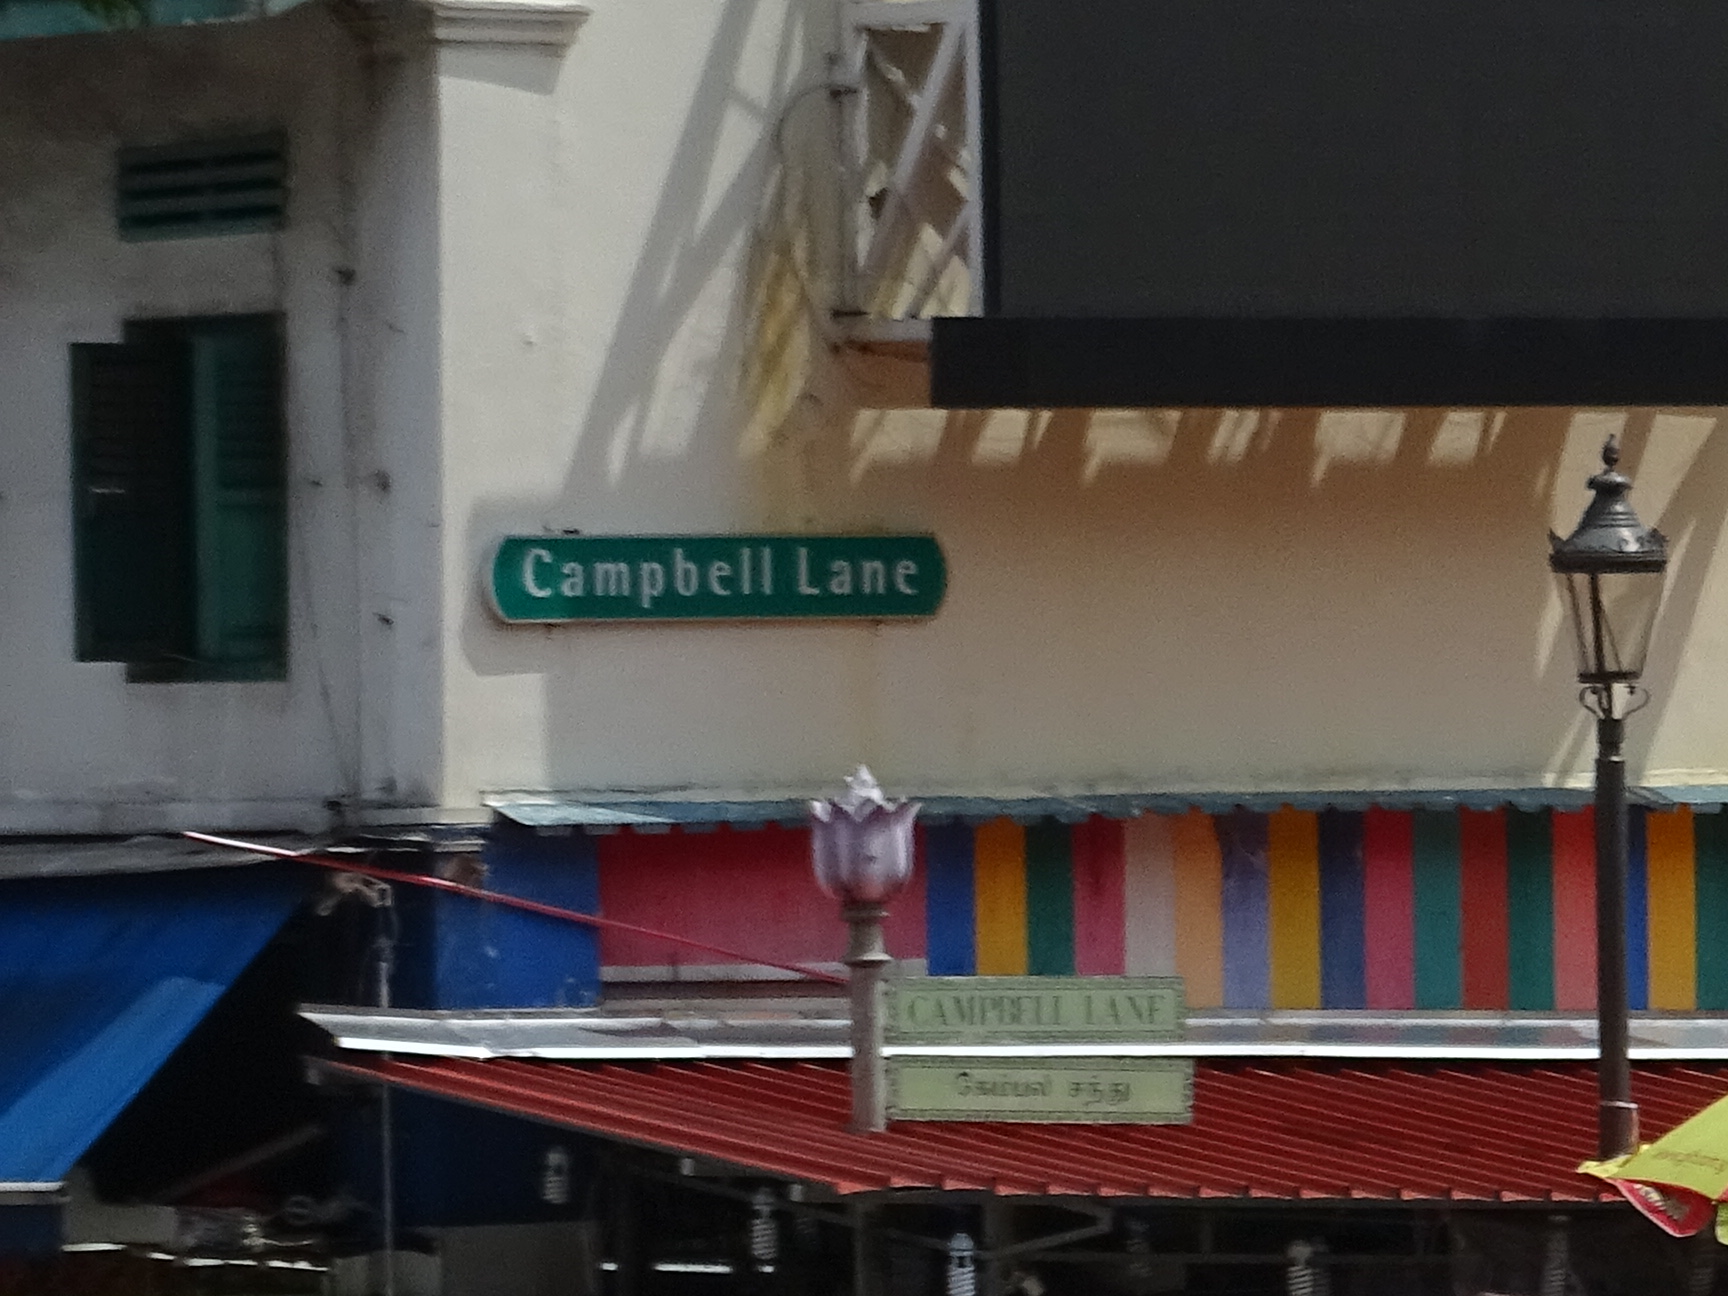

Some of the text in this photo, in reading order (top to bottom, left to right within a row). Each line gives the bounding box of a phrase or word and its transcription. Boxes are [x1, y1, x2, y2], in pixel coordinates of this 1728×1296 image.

[522, 546, 921, 609] Campbell Lane
[907, 994, 1166, 1027] CAMPBELL LANE
